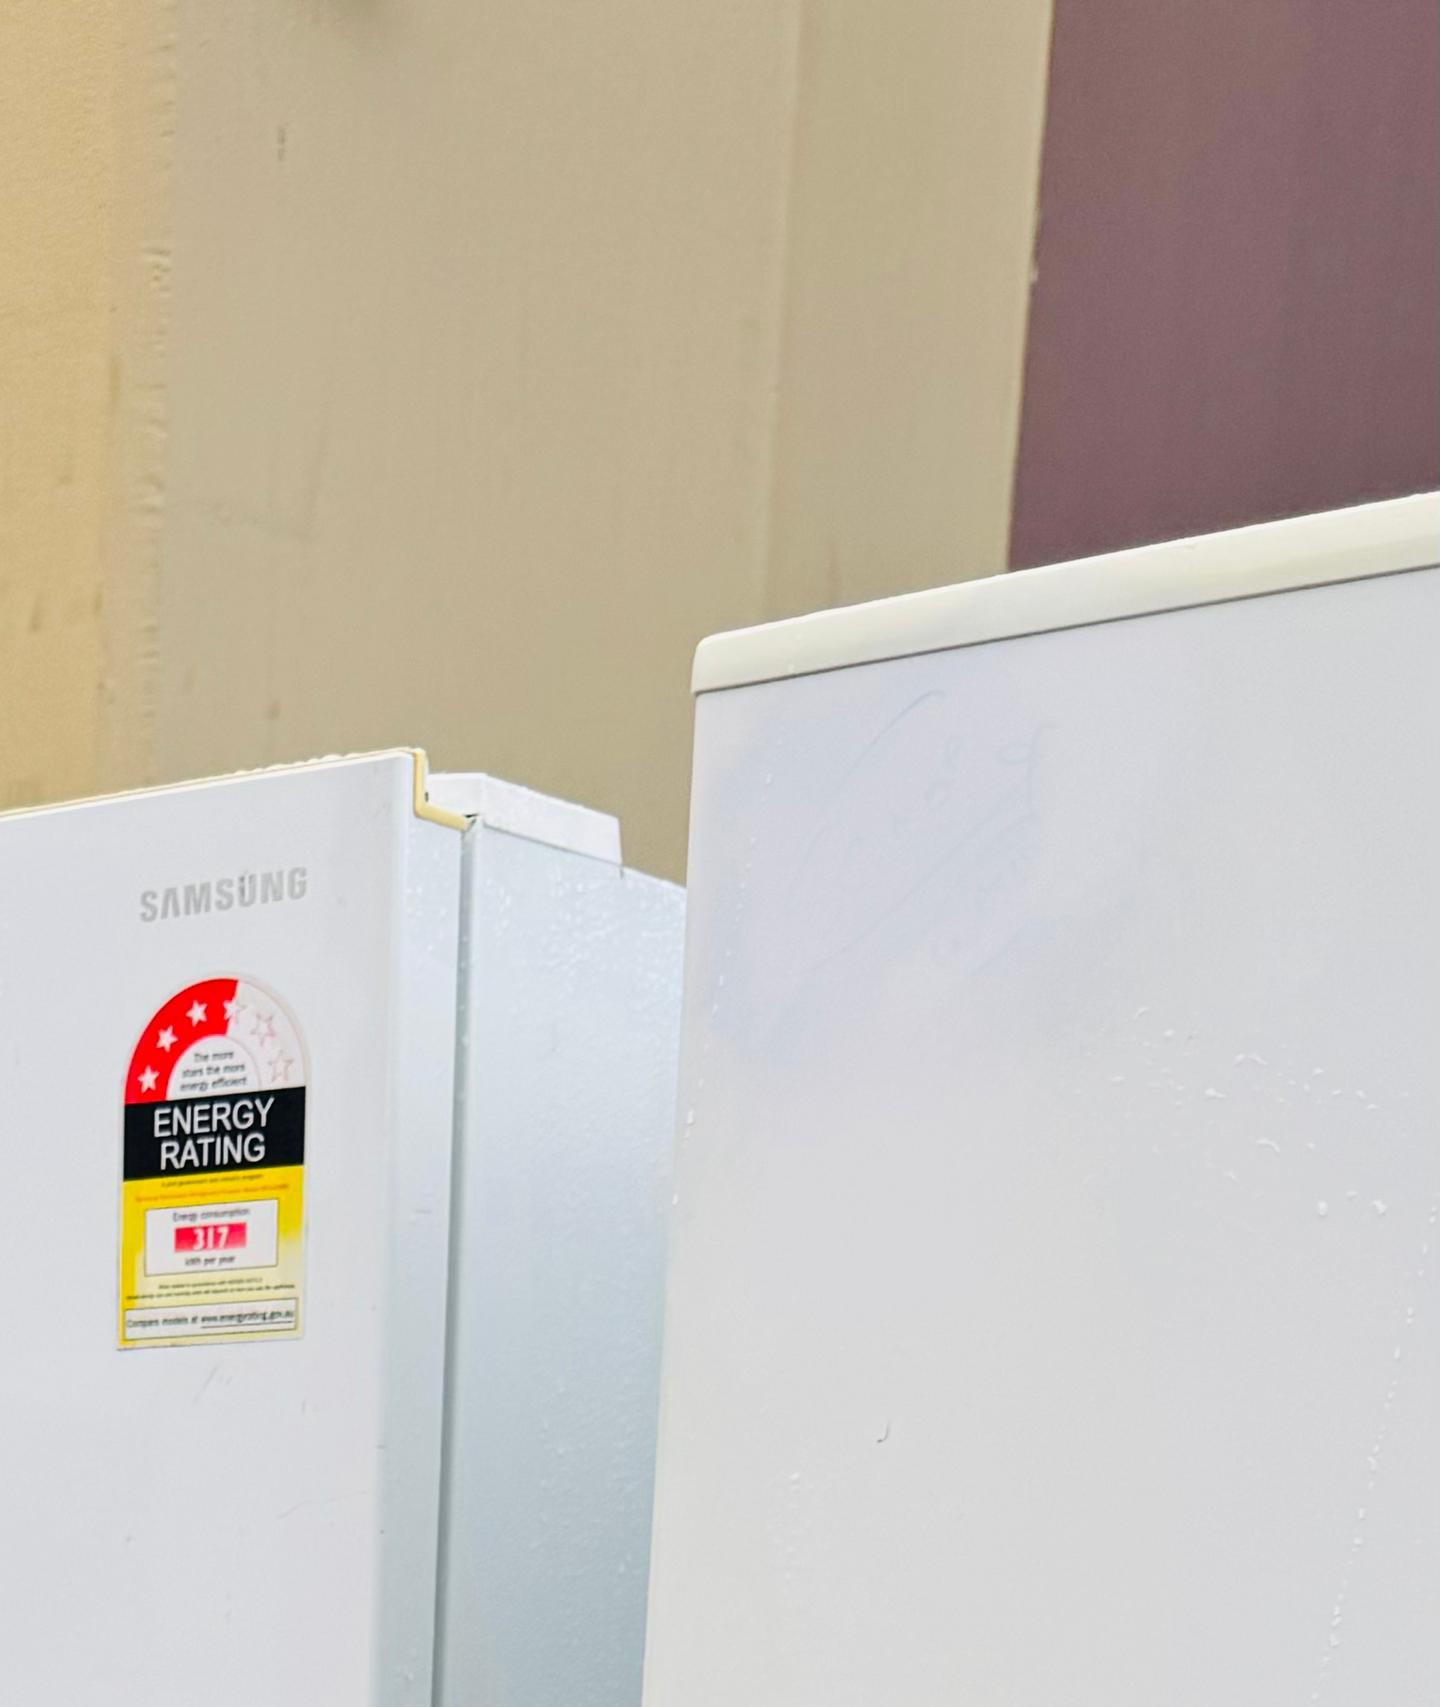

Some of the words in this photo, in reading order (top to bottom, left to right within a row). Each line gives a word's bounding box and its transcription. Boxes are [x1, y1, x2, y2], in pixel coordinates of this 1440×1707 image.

[140, 866, 308, 923] SAMSUNG
[153, 1096, 275, 1138] ENERGY
[160, 1132, 266, 1171] RATING
[193, 1226, 229, 1250] 317
